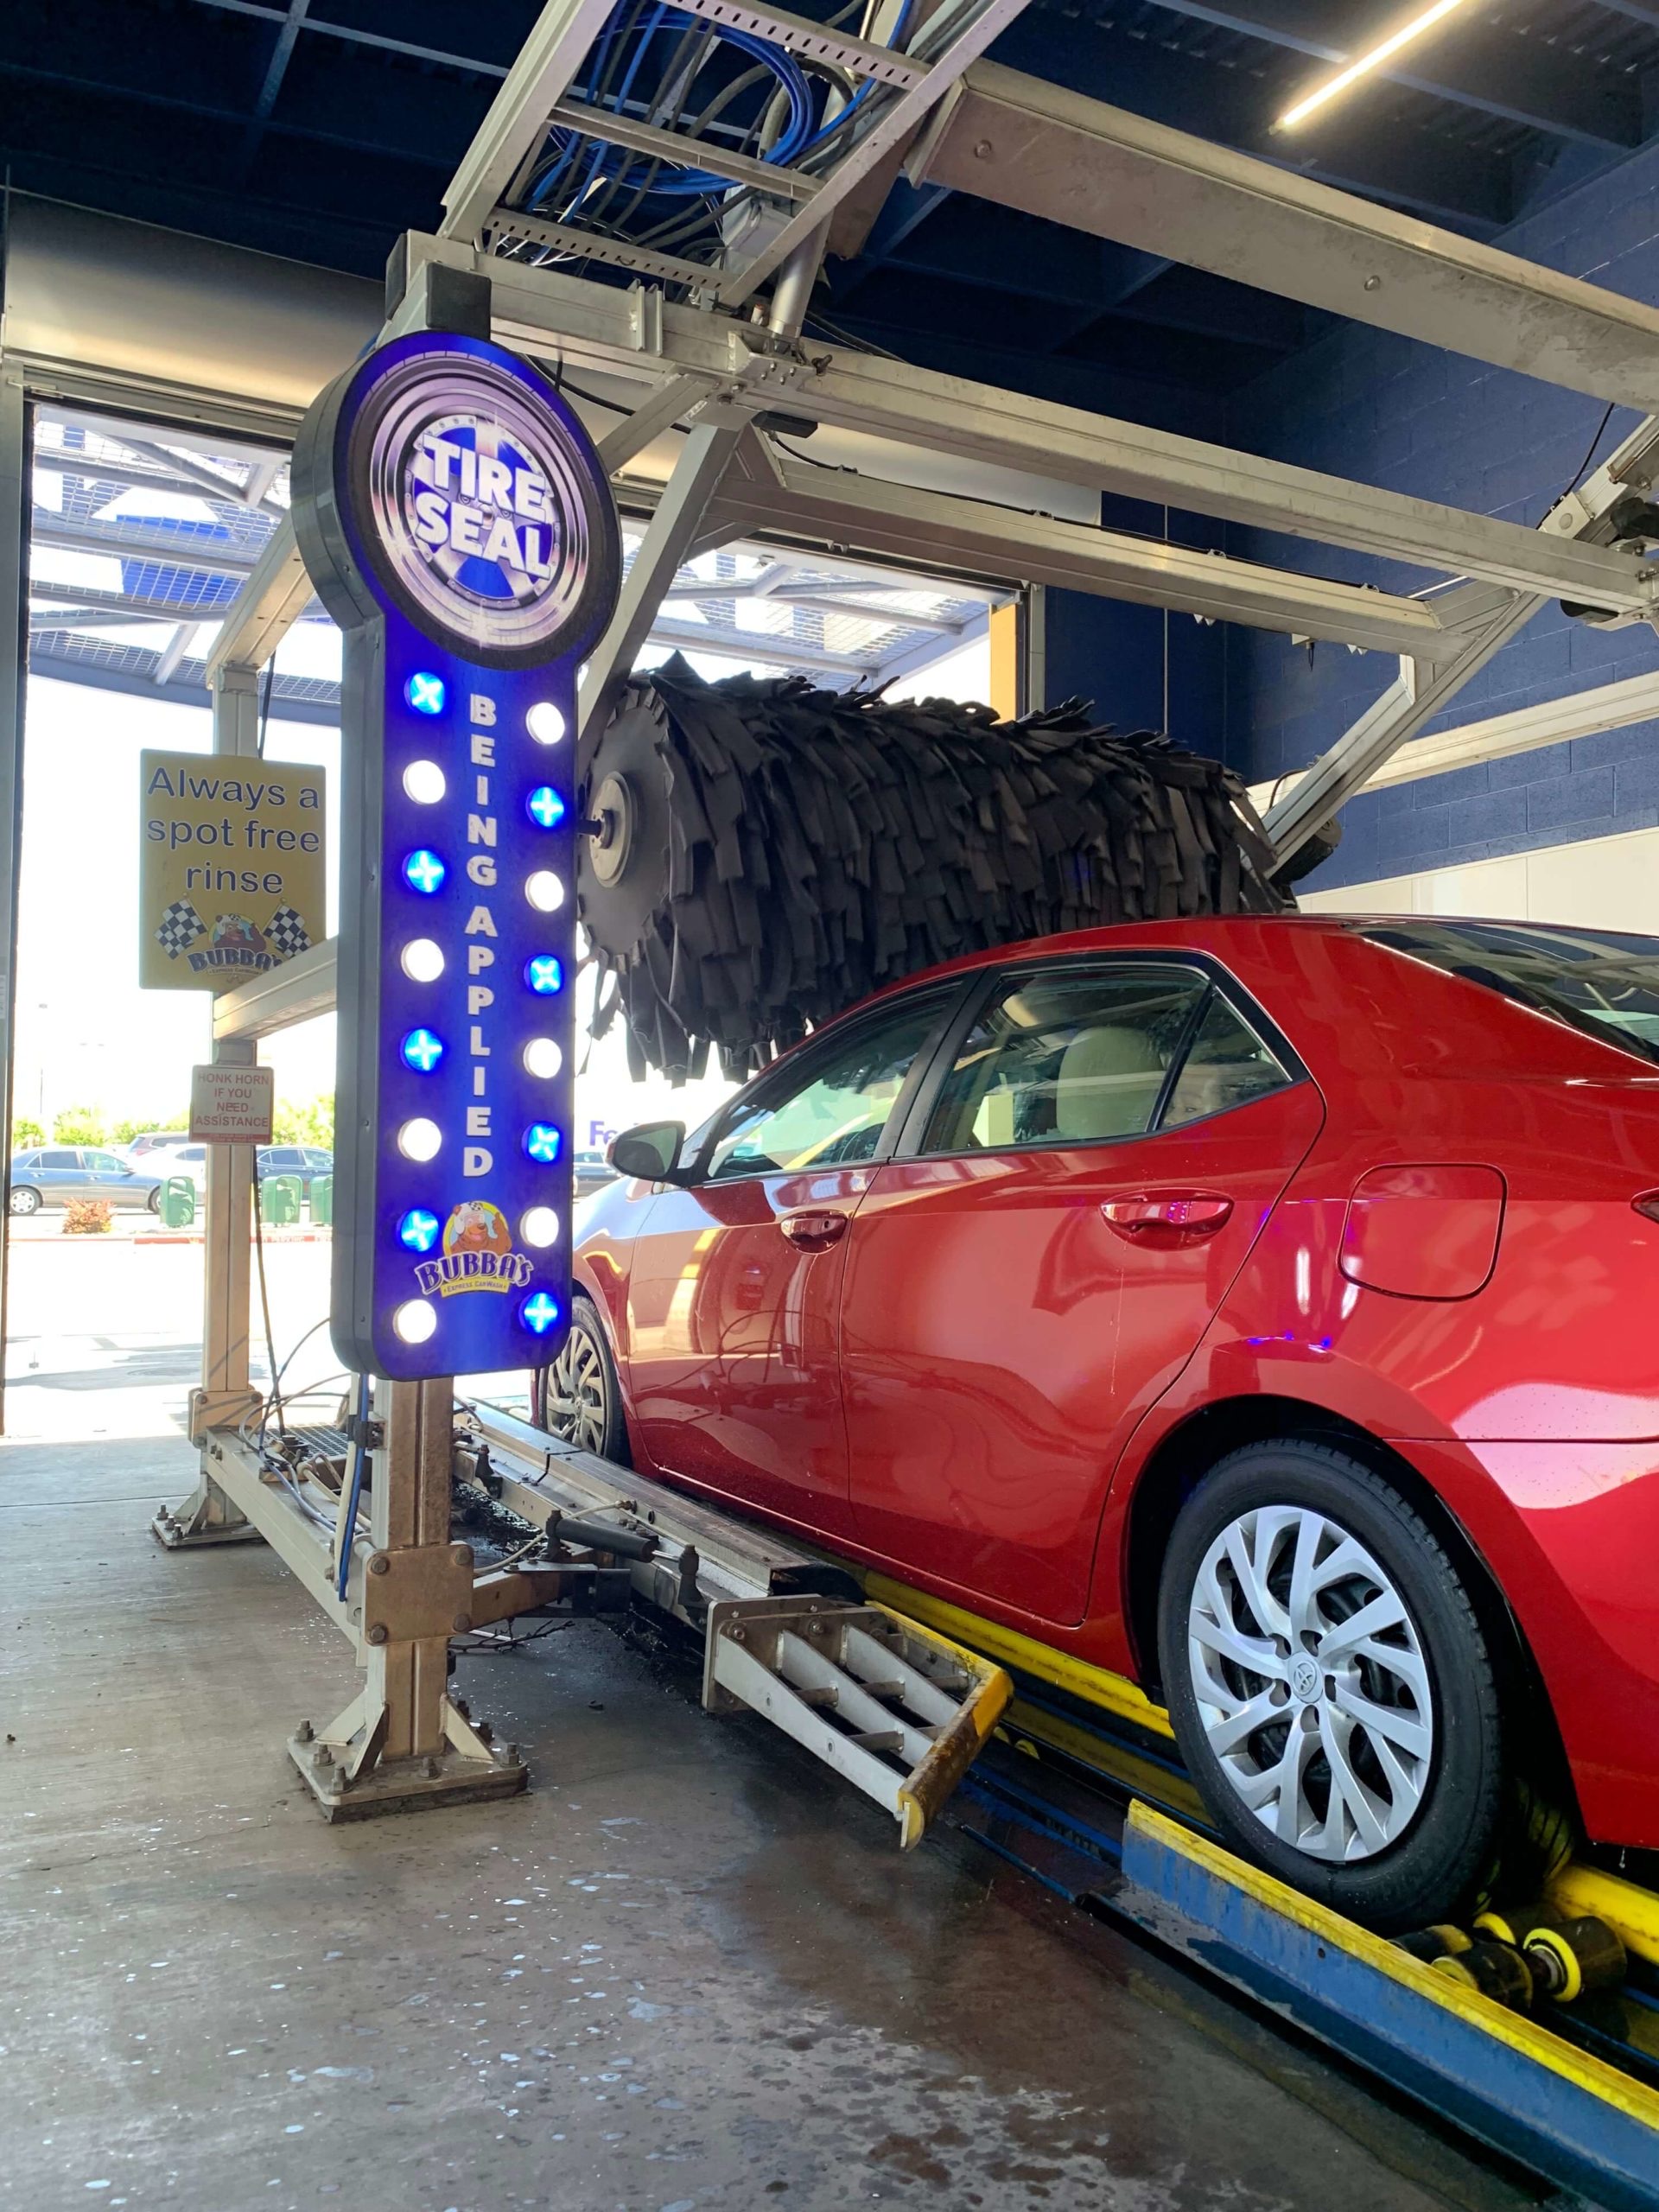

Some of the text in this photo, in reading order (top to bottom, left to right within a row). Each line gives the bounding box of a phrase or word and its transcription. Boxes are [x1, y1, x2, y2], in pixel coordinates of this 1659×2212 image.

[423, 433, 546, 523] TIRE
[415, 492, 551, 582] SEAL
[147, 766, 319, 811] Always a
[467, 693, 497, 887] BEING
[147, 818, 320, 853] spot free
[187, 861, 283, 894] rinse
[464, 906, 498, 1177] APPLIED
[198, 1073, 269, 1085] HONK HORN
[214, 1088, 252, 1098] IF YOU
[195, 1116, 269, 1127] ASSISTANCE
[216, 1102, 249, 1113] NEED
[415, 1250, 534, 1295] BUBBA'S
[447, 1281, 473, 1293] EXPRESS
